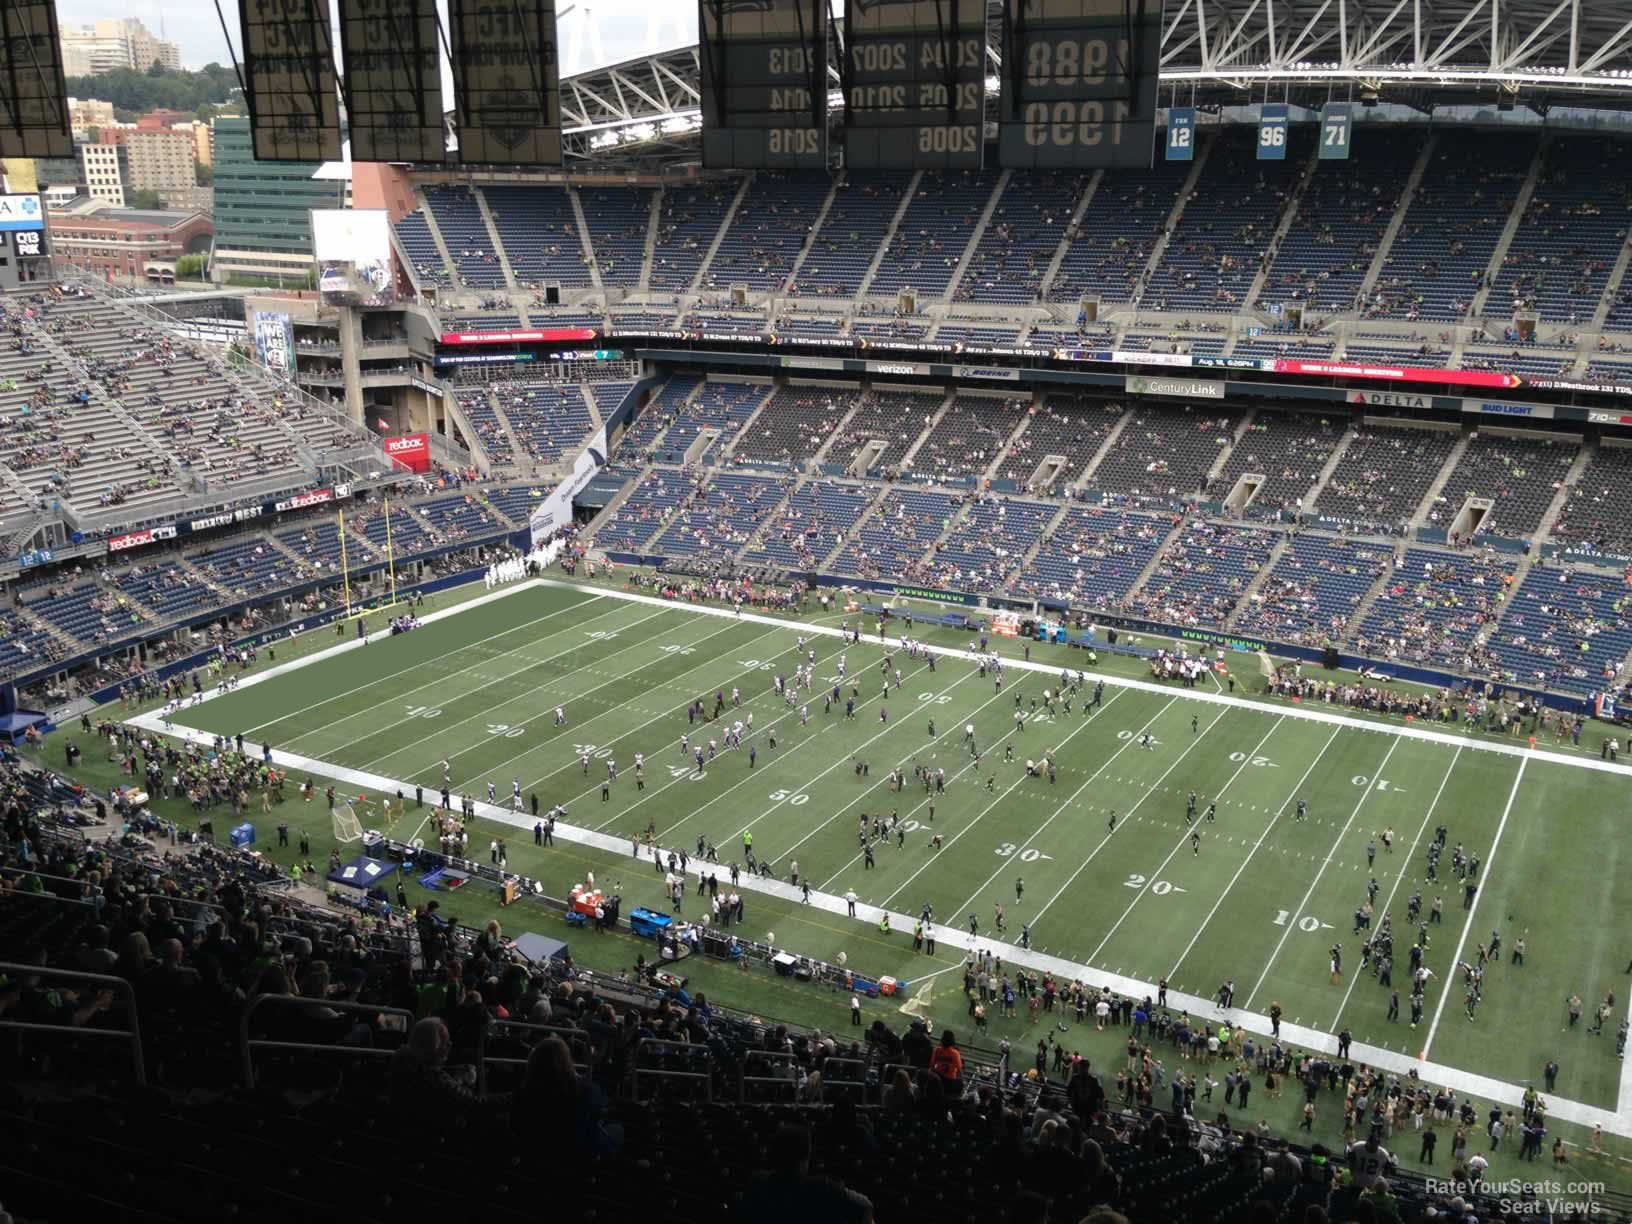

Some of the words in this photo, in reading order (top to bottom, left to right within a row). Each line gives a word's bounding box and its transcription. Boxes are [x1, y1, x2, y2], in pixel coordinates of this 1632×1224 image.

[1171, 128, 1190, 147] 12
[1260, 127, 1284, 146] 96
[1325, 126, 1345, 145] 71
[18, 244, 40, 255] FOX
[264, 324, 283, 337] WE
[266, 337, 284, 348] ARE
[877, 364, 913, 374] verizon
[972, 369, 1011, 377] BOEING
[1150, 381, 1216, 395] CenturyLink
[1371, 394, 1424, 407] DELTA
[1482, 403, 1502, 412] BUD
[1503, 405, 1533, 415] LIGHT
[1588, 413, 1608, 421] 710
[1326, 516, 1351, 524] DELTA
[1574, 548, 1602, 557] DELTA
[1228, 751, 1271, 767] 20
[1351, 775, 1390, 791] 10
[769, 790, 809, 805] 50
[994, 843, 1041, 863] 30
[1123, 874, 1175, 895] 20
[1272, 910, 1321, 932] 10
